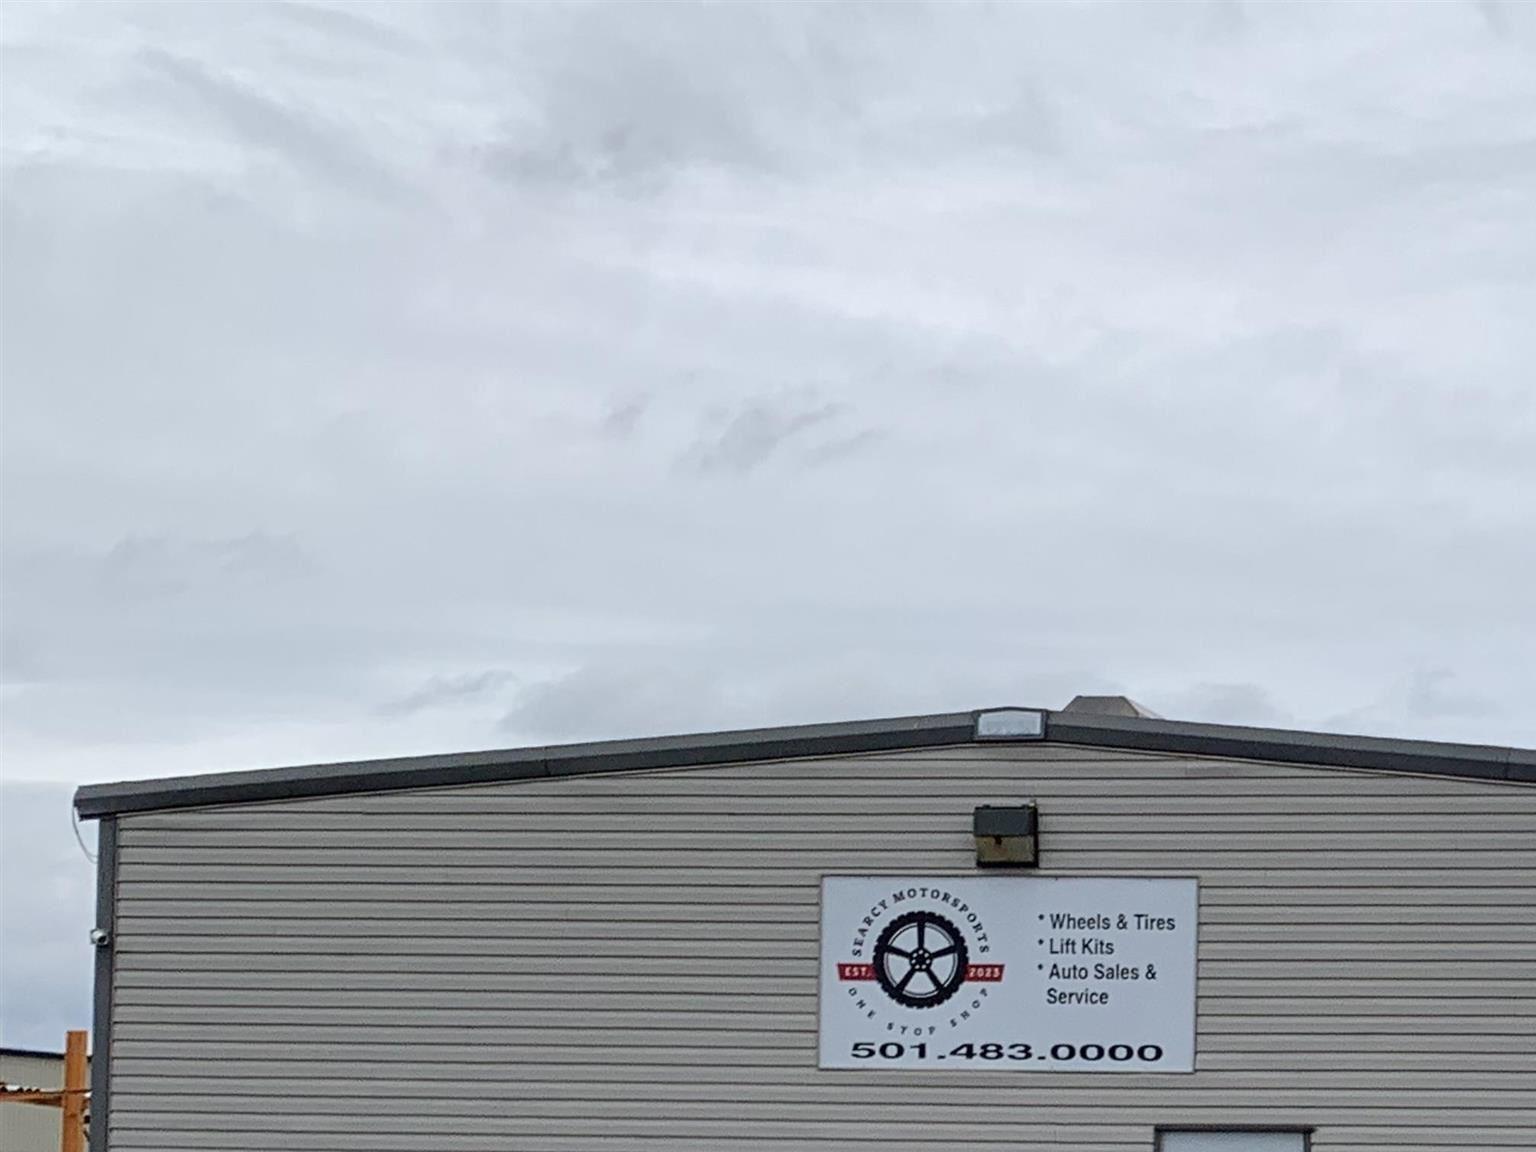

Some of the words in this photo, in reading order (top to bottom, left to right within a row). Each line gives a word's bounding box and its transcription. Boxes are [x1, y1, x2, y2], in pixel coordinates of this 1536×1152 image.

[852, 899, 888, 957] SEARCY
[892, 887, 990, 953] MOTORSPORTS
[1049, 913, 1111, 930] Wheels
[1116, 914, 1128, 930] &
[1133, 914, 1176, 930] Tires
[1049, 938, 1076, 955] Lift
[1081, 938, 1115, 955] Kits
[1048, 963, 1089, 980] Auto
[1093, 963, 1140, 980] Sales
[1145, 964, 1157, 980] &
[1046, 987, 1109, 1005] Service
[848, 987, 876, 1019] ONE
[887, 1022, 936, 1036] STOP
[950, 988, 990, 1028] SHOP
[851, 1042, 1164, 1062] 501.483.0000
